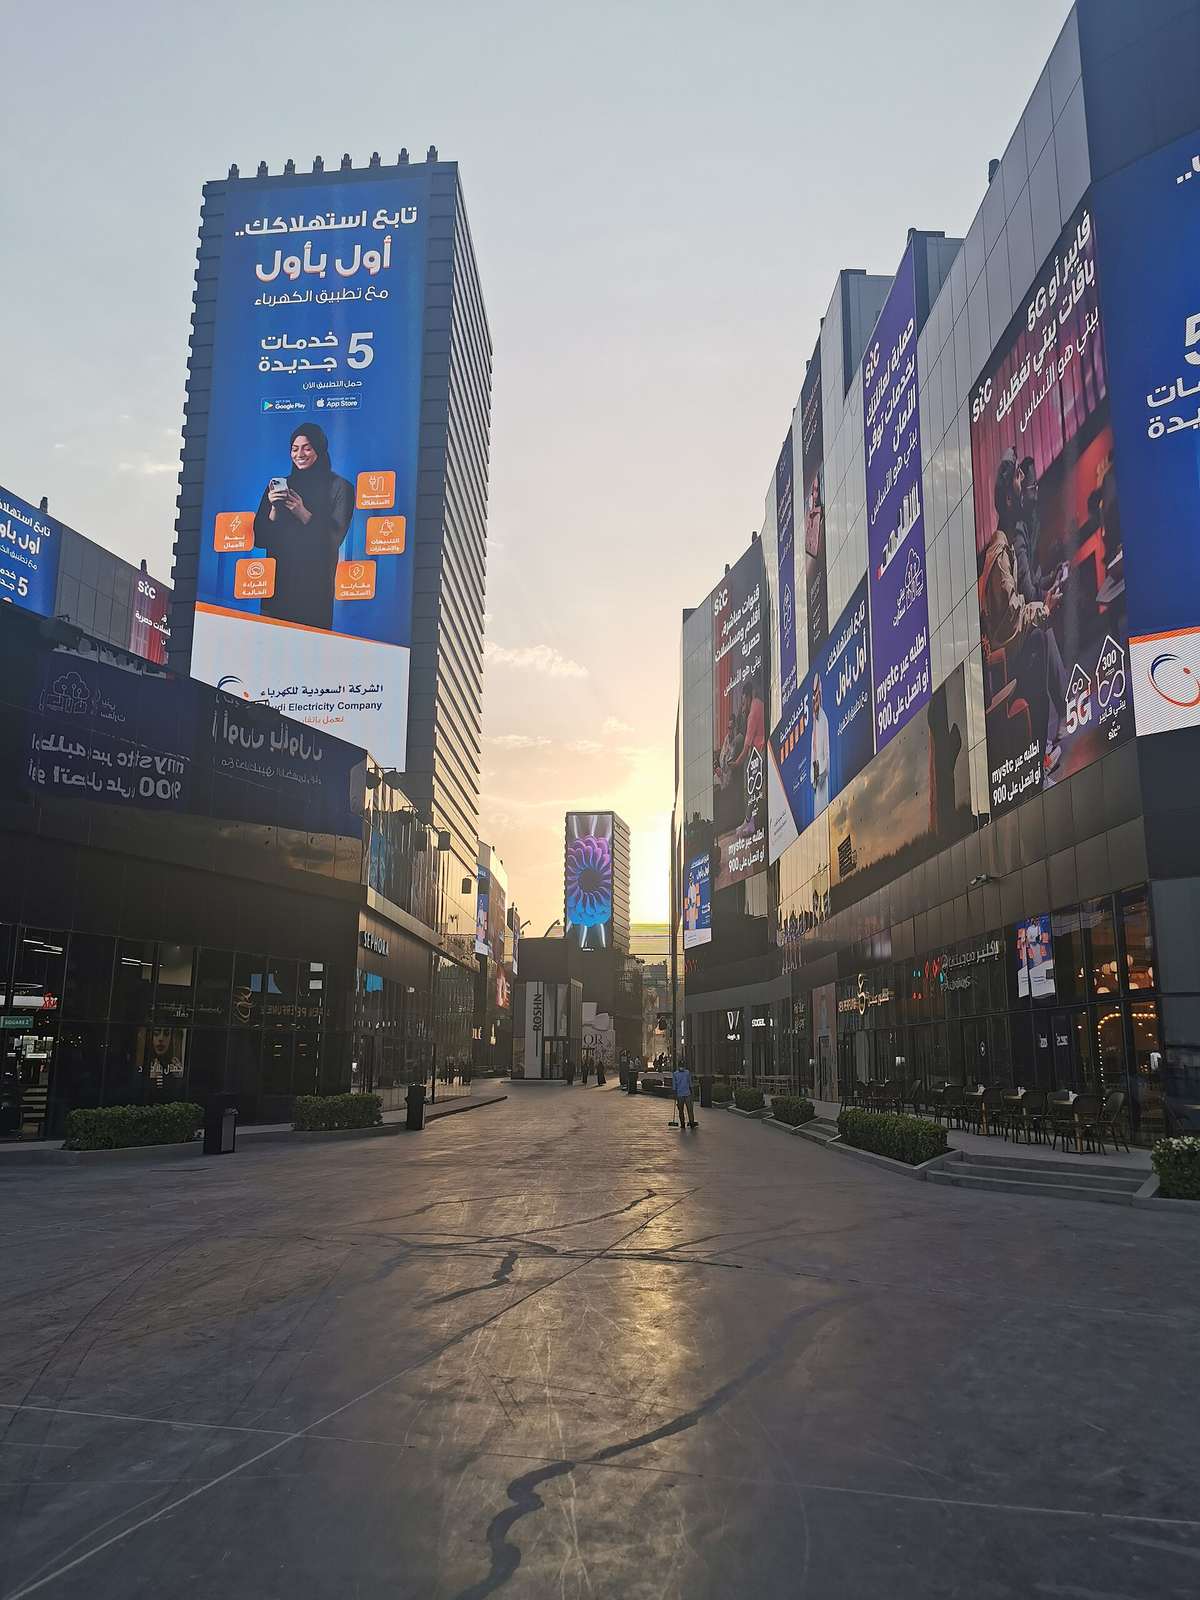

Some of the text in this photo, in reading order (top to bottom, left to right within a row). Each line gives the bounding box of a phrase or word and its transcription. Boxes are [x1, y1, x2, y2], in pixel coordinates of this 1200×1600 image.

[372, 206, 417, 230] تابع
[255, 235, 392, 282] أول بأول
[1048, 255, 1061, 299] أو
[254, 286, 389, 307] مع تطبيق الكهرباء
[1058, 258, 1095, 326] باقات
[1026, 286, 1047, 333] 5G
[261, 331, 339, 350] خدمات
[347, 332, 374, 369] 5
[258, 356, 338, 374] جديدة
[865, 342, 880, 388] stc
[1056, 343, 1073, 380] هو
[972, 377, 993, 423] stc
[18, 577, 29, 597] 5
[137, 580, 156, 600] stc
[714, 588, 728, 617] stc
[1102, 649, 1117, 671] 300
[261, 684, 383, 698] الشركة السعودية للكهرباء
[876, 663, 899, 704] mystc
[288, 702, 334, 712] Electricity
[338, 701, 382, 712] Company
[878, 702, 892, 735] 900
[1066, 690, 1092, 734] 5G
[991, 759, 1013, 784] mystc
[993, 783, 1007, 806] 900
[729, 857, 739, 873] 900
[533, 993, 543, 1031] ROSHN
